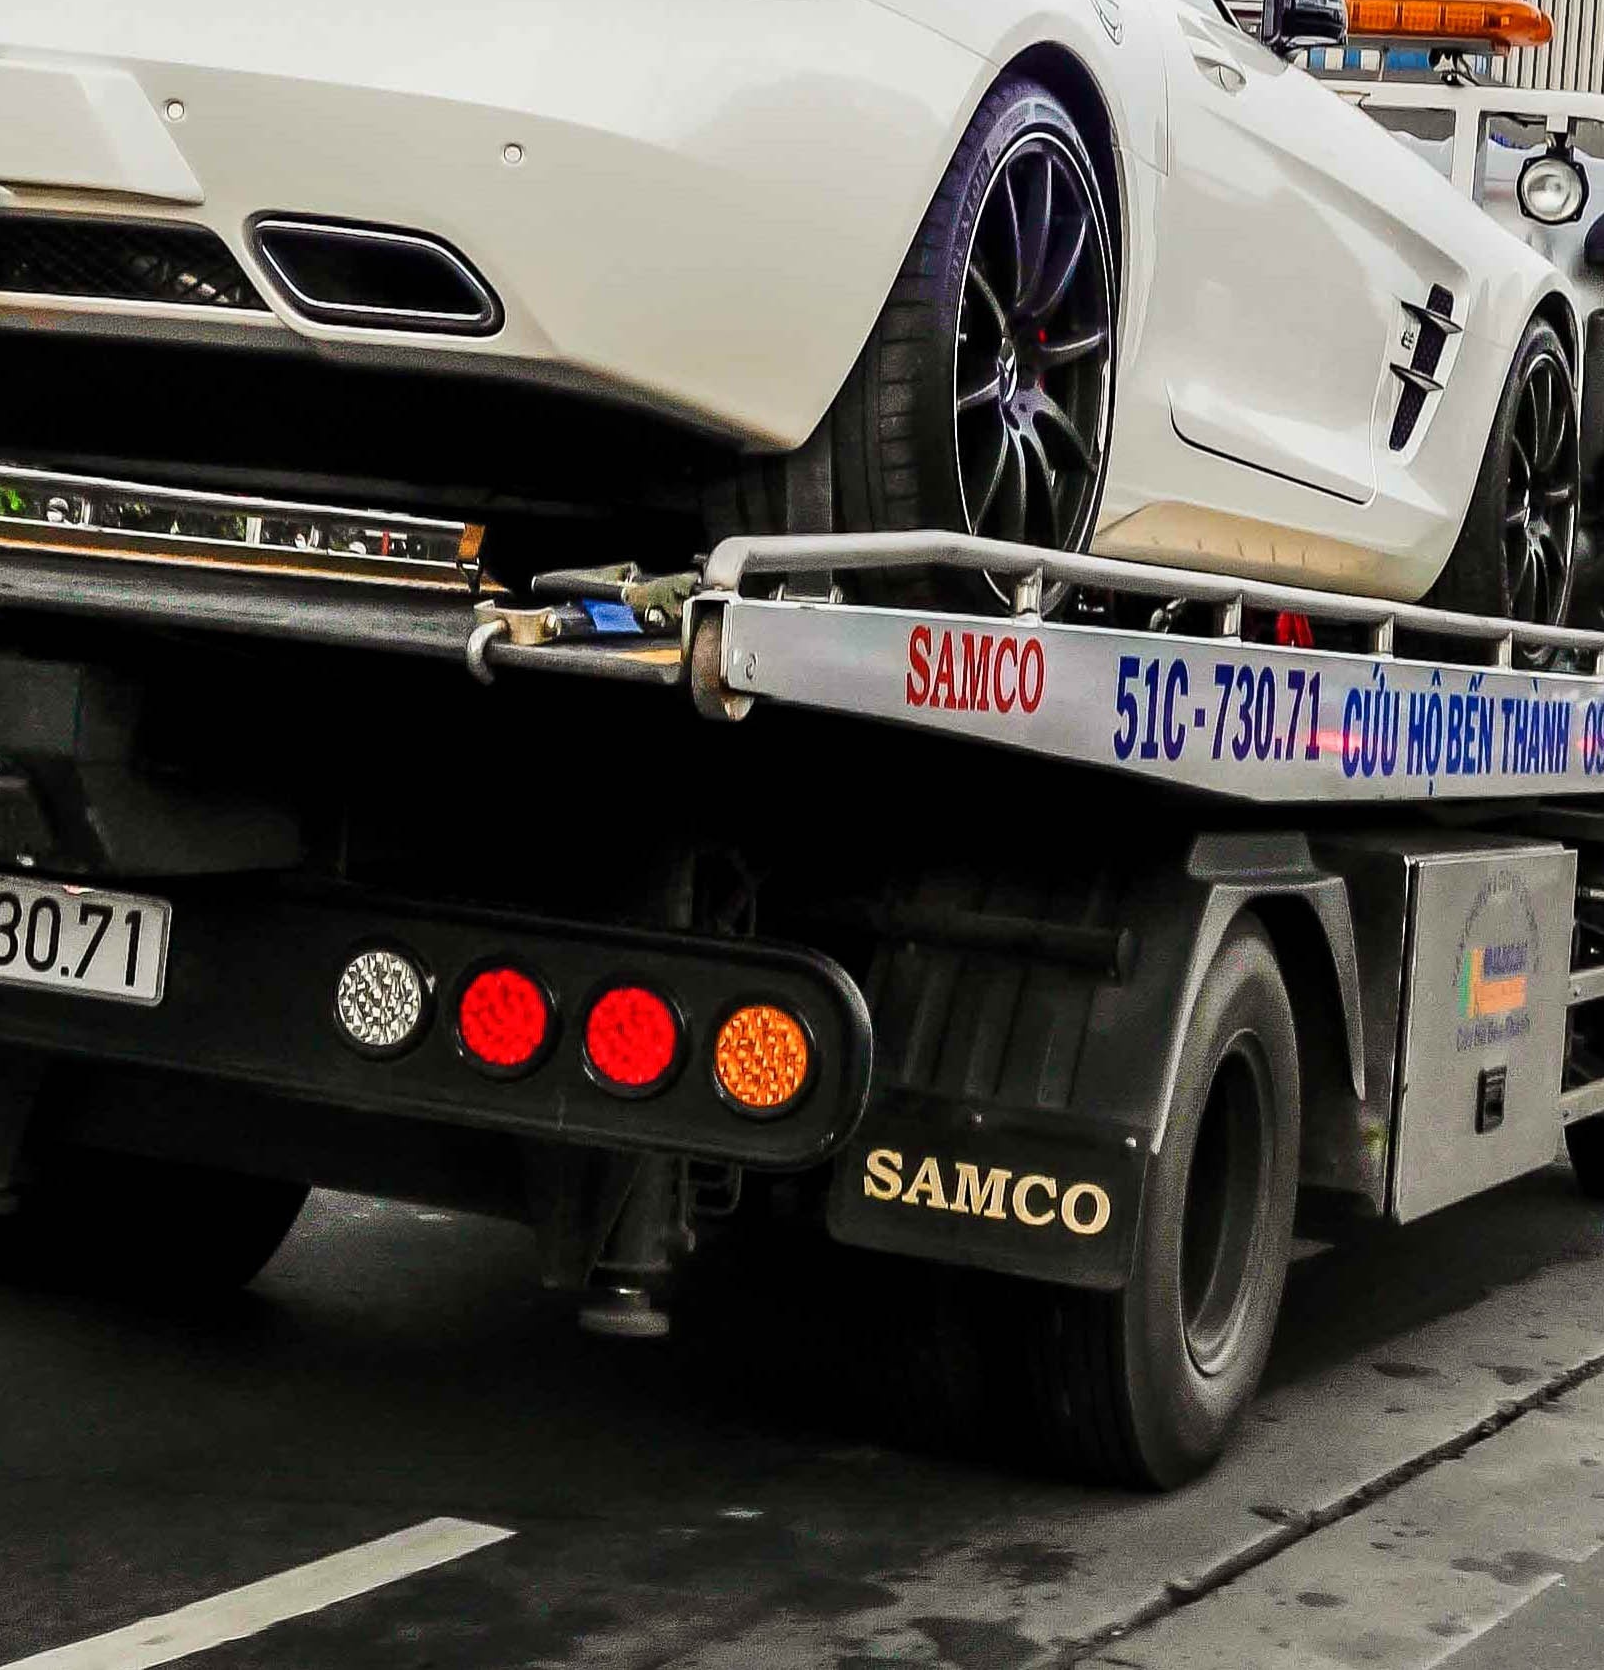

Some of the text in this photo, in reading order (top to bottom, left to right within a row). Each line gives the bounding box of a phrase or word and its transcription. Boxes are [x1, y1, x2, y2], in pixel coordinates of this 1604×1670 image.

[905, 626, 1045, 714] SAMCO
[1113, 655, 1321, 761] 51C-730.71
[1343, 663, 1400, 778] CỨU
[1406, 667, 1443, 796] HỘ
[1446, 672, 1494, 775] BẾN
[1502, 678, 1570, 775] THÀNH
[863, 1148, 1111, 1234] SAMCO
